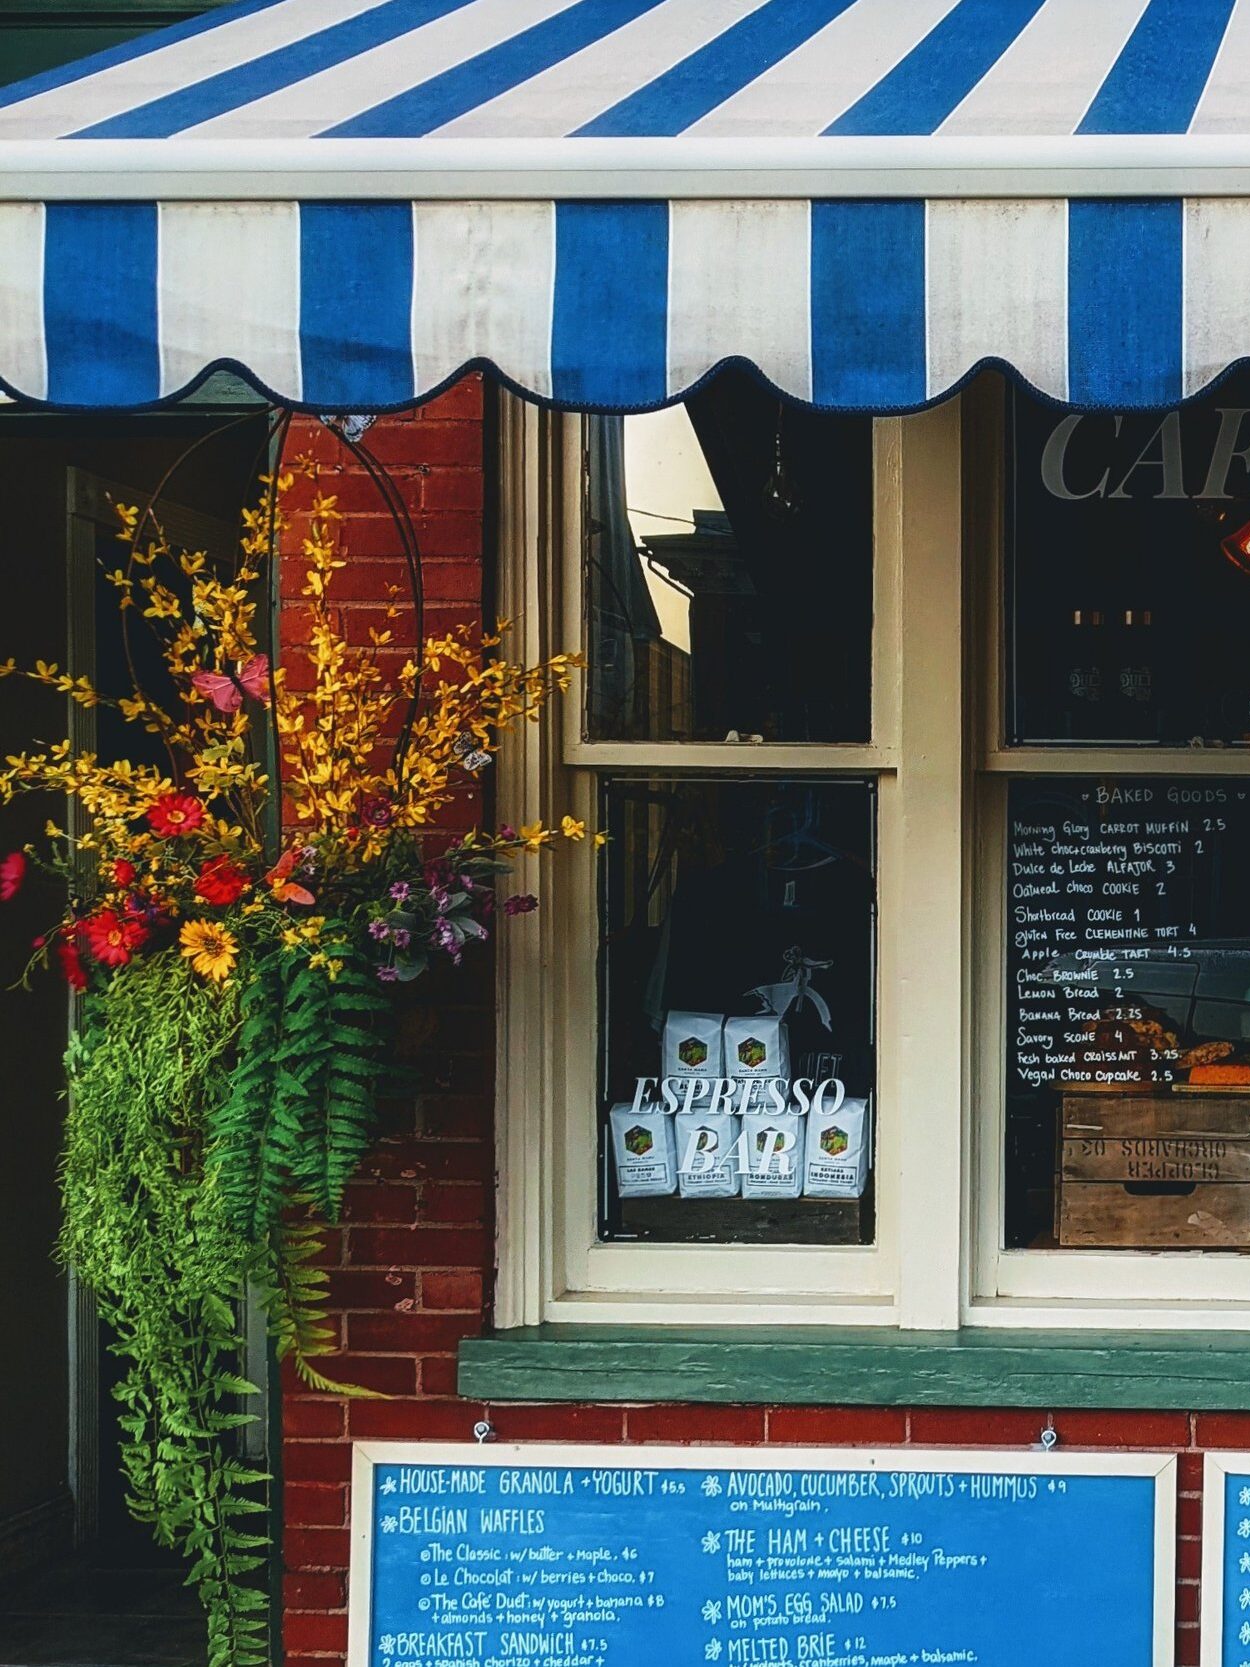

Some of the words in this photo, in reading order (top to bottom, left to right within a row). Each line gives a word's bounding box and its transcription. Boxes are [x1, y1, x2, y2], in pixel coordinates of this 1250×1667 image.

[1096, 786, 1153, 804] BAKED
[1167, 786, 1227, 803] GOODS
[1063, 820, 1090, 840] Glory
[1100, 823, 1140, 834] CARROT
[1203, 818, 1226, 832] 2.5
[1013, 843, 1045, 858] White
[1195, 840, 1204, 854] 2
[1013, 862, 1046, 876] Dulce
[1050, 862, 1065, 875] de
[1069, 860, 1096, 873] Leche
[1107, 860, 1157, 877] ALFAJOR
[1166, 860, 1176, 874] 3
[1013, 883, 1060, 898] Oatmeal
[1066, 882, 1093, 894] choco
[1156, 882, 1167, 896] 2
[1014, 906, 1075, 924] Shortbread
[1087, 909, 1123, 921] COOKIE
[1134, 909, 1141, 921] 1
[1056, 929, 1077, 940] Free
[1085, 928, 1149, 939] CLEMENTINE
[1189, 923, 1197, 936] 4
[1021, 949, 1060, 960] Apple
[1122, 949, 1150, 960] TART
[1167, 946, 1192, 958] 4.5
[1113, 968, 1134, 980] 2.5
[1065, 987, 1099, 999] Bread
[1115, 987, 1124, 999] 2
[1069, 1009, 1101, 1021] Bread
[1116, 1009, 1143, 1020] 2.25
[1017, 1027, 1053, 1049] Savory
[1064, 1031, 1096, 1043] SCONE
[1115, 1030, 1123, 1043] 4
[1045, 1051, 1075, 1064] baked
[1084, 1051, 1138, 1061] CROISSANT
[1017, 1068, 1055, 1087] Vegan
[1060, 1069, 1091, 1081] Choco
[1095, 1070, 1141, 1084] Cupcake
[1151, 1070, 1174, 1082] 2.5
[628, 1075, 846, 1117] ESPRESSO
[676, 1130, 797, 1175] BAR
[1121, 1139, 1227, 1158] ORCHARDS
[810, 1172, 854, 1180] INDONESIA
[400, 1468, 486, 1494] HOUSE-MADE
[500, 1470, 574, 1495] GRANOLA
[889, 1472, 954, 1499] SPROUTS
[1047, 1479, 1067, 1494] $9
[730, 1500, 748, 1512] on
[400, 1505, 468, 1535] BELGIAN
[481, 1509, 545, 1535] WAFFLES
[724, 1529, 756, 1555] THE
[769, 1529, 807, 1555] HAM
[829, 1526, 890, 1553] CHEESE
[901, 1532, 923, 1546] $10
[428, 1542, 453, 1562] The
[456, 1543, 501, 1561] Classic
[622, 1546, 638, 1561] $6
[727, 1554, 753, 1567] ham
[836, 1554, 875, 1566] salami
[888, 1553, 929, 1571] Medley
[931, 1548, 978, 1568] Peppers
[435, 1567, 450, 1586] Le
[454, 1567, 514, 1587] Chocolat
[541, 1569, 586, 1584] berries
[728, 1568, 754, 1585] baby
[760, 1566, 805, 1580] lettuces
[818, 1569, 849, 1583] mayo
[430, 1592, 458, 1611] The
[461, 1591, 492, 1611] Café
[547, 1594, 585, 1614] yogurt
[595, 1595, 644, 1609] banana
[647, 1594, 665, 1608] $8
[727, 1594, 778, 1619] MOM'S
[785, 1593, 813, 1617] EGG
[820, 1591, 864, 1613] SALAD
[871, 1596, 897, 1610] $7.5
[441, 1611, 493, 1625] almonds
[506, 1610, 545, 1629] honey
[731, 1617, 748, 1629] on
[753, 1615, 790, 1630] potato
[397, 1632, 488, 1657] BREAKFAST
[500, 1632, 575, 1657] SANDWICH
[581, 1638, 608, 1651] $7.5
[728, 1637, 788, 1662] MELTED
[797, 1632, 836, 1658] BRIE
[484, 1656, 531, 1667] chorizo
[543, 1655, 594, 1667] cheddar
[871, 1653, 907, 1667] maple
